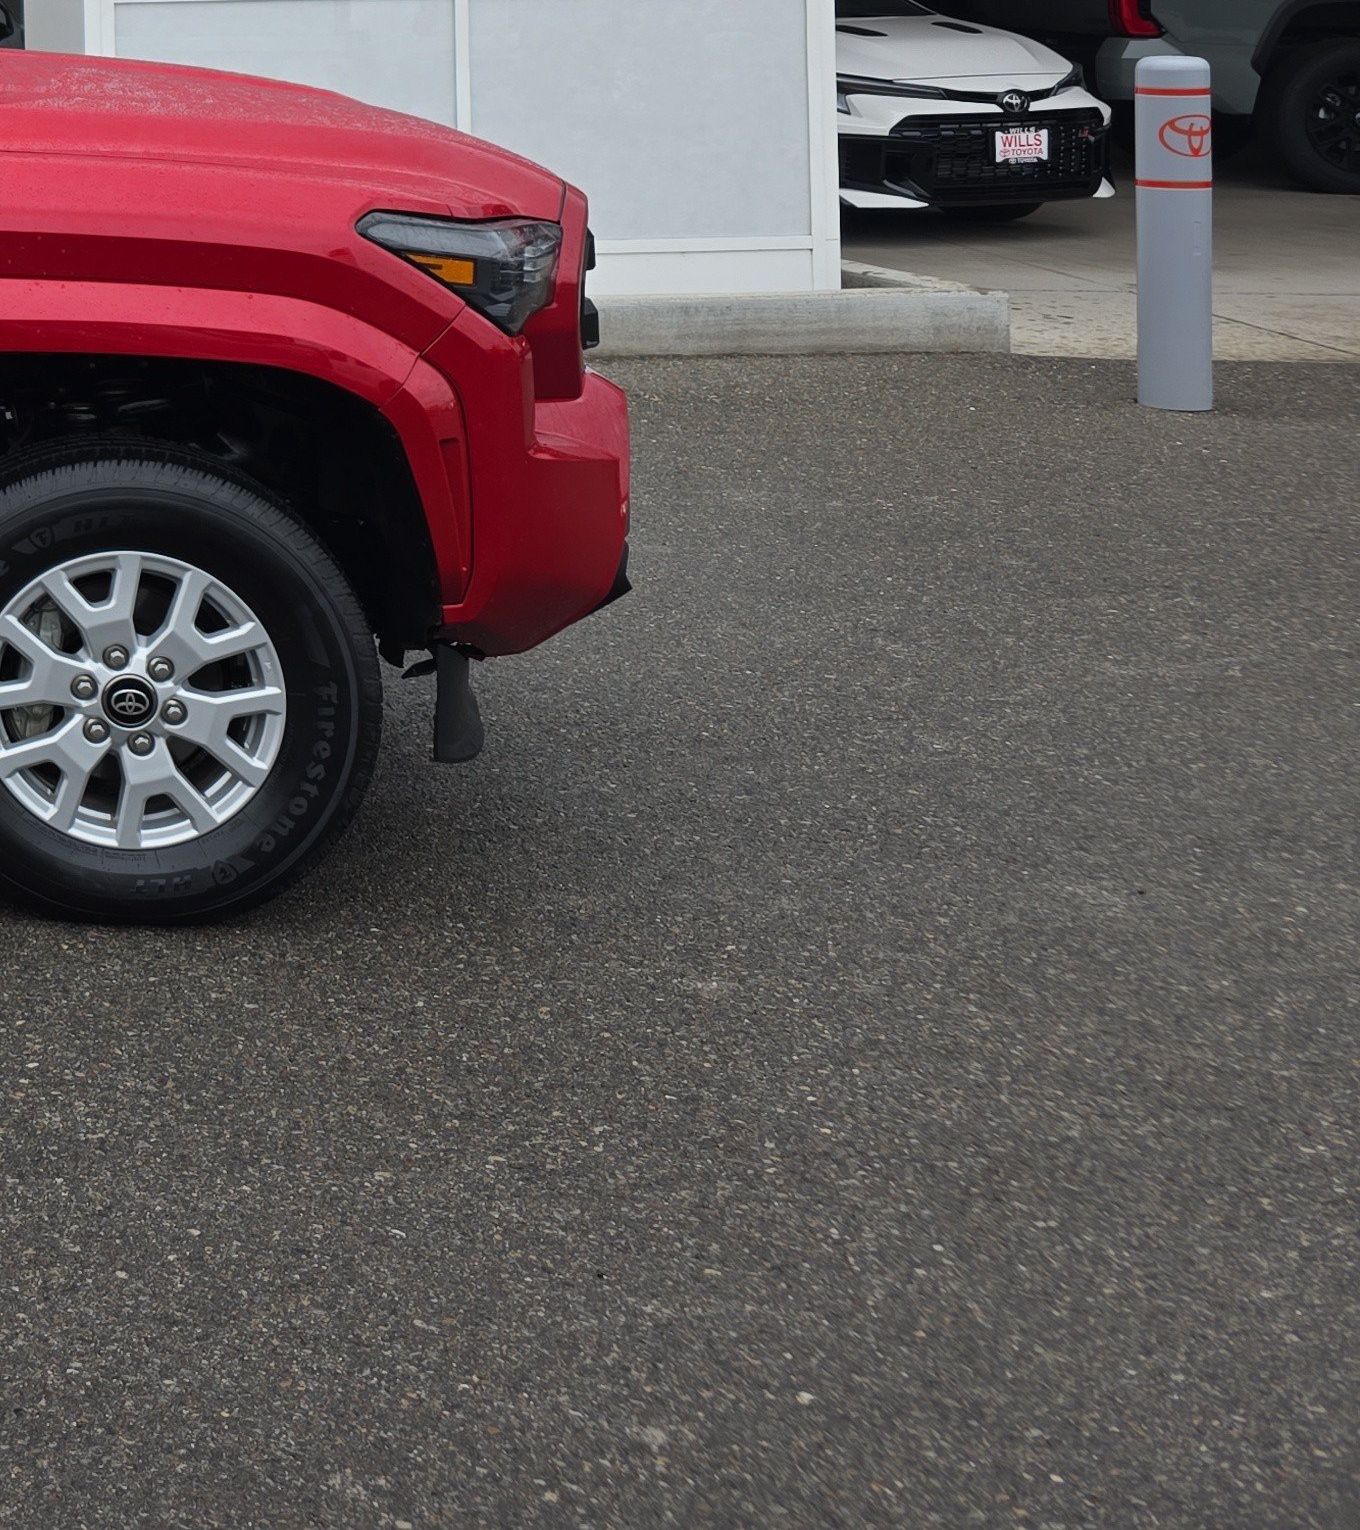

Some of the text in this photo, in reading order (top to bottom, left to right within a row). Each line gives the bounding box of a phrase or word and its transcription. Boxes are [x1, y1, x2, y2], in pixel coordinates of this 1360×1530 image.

[1001, 134, 1043, 147] WILLS
[1011, 148, 1044, 156] TOYOTA
[255, 680, 340, 853] Firestone
